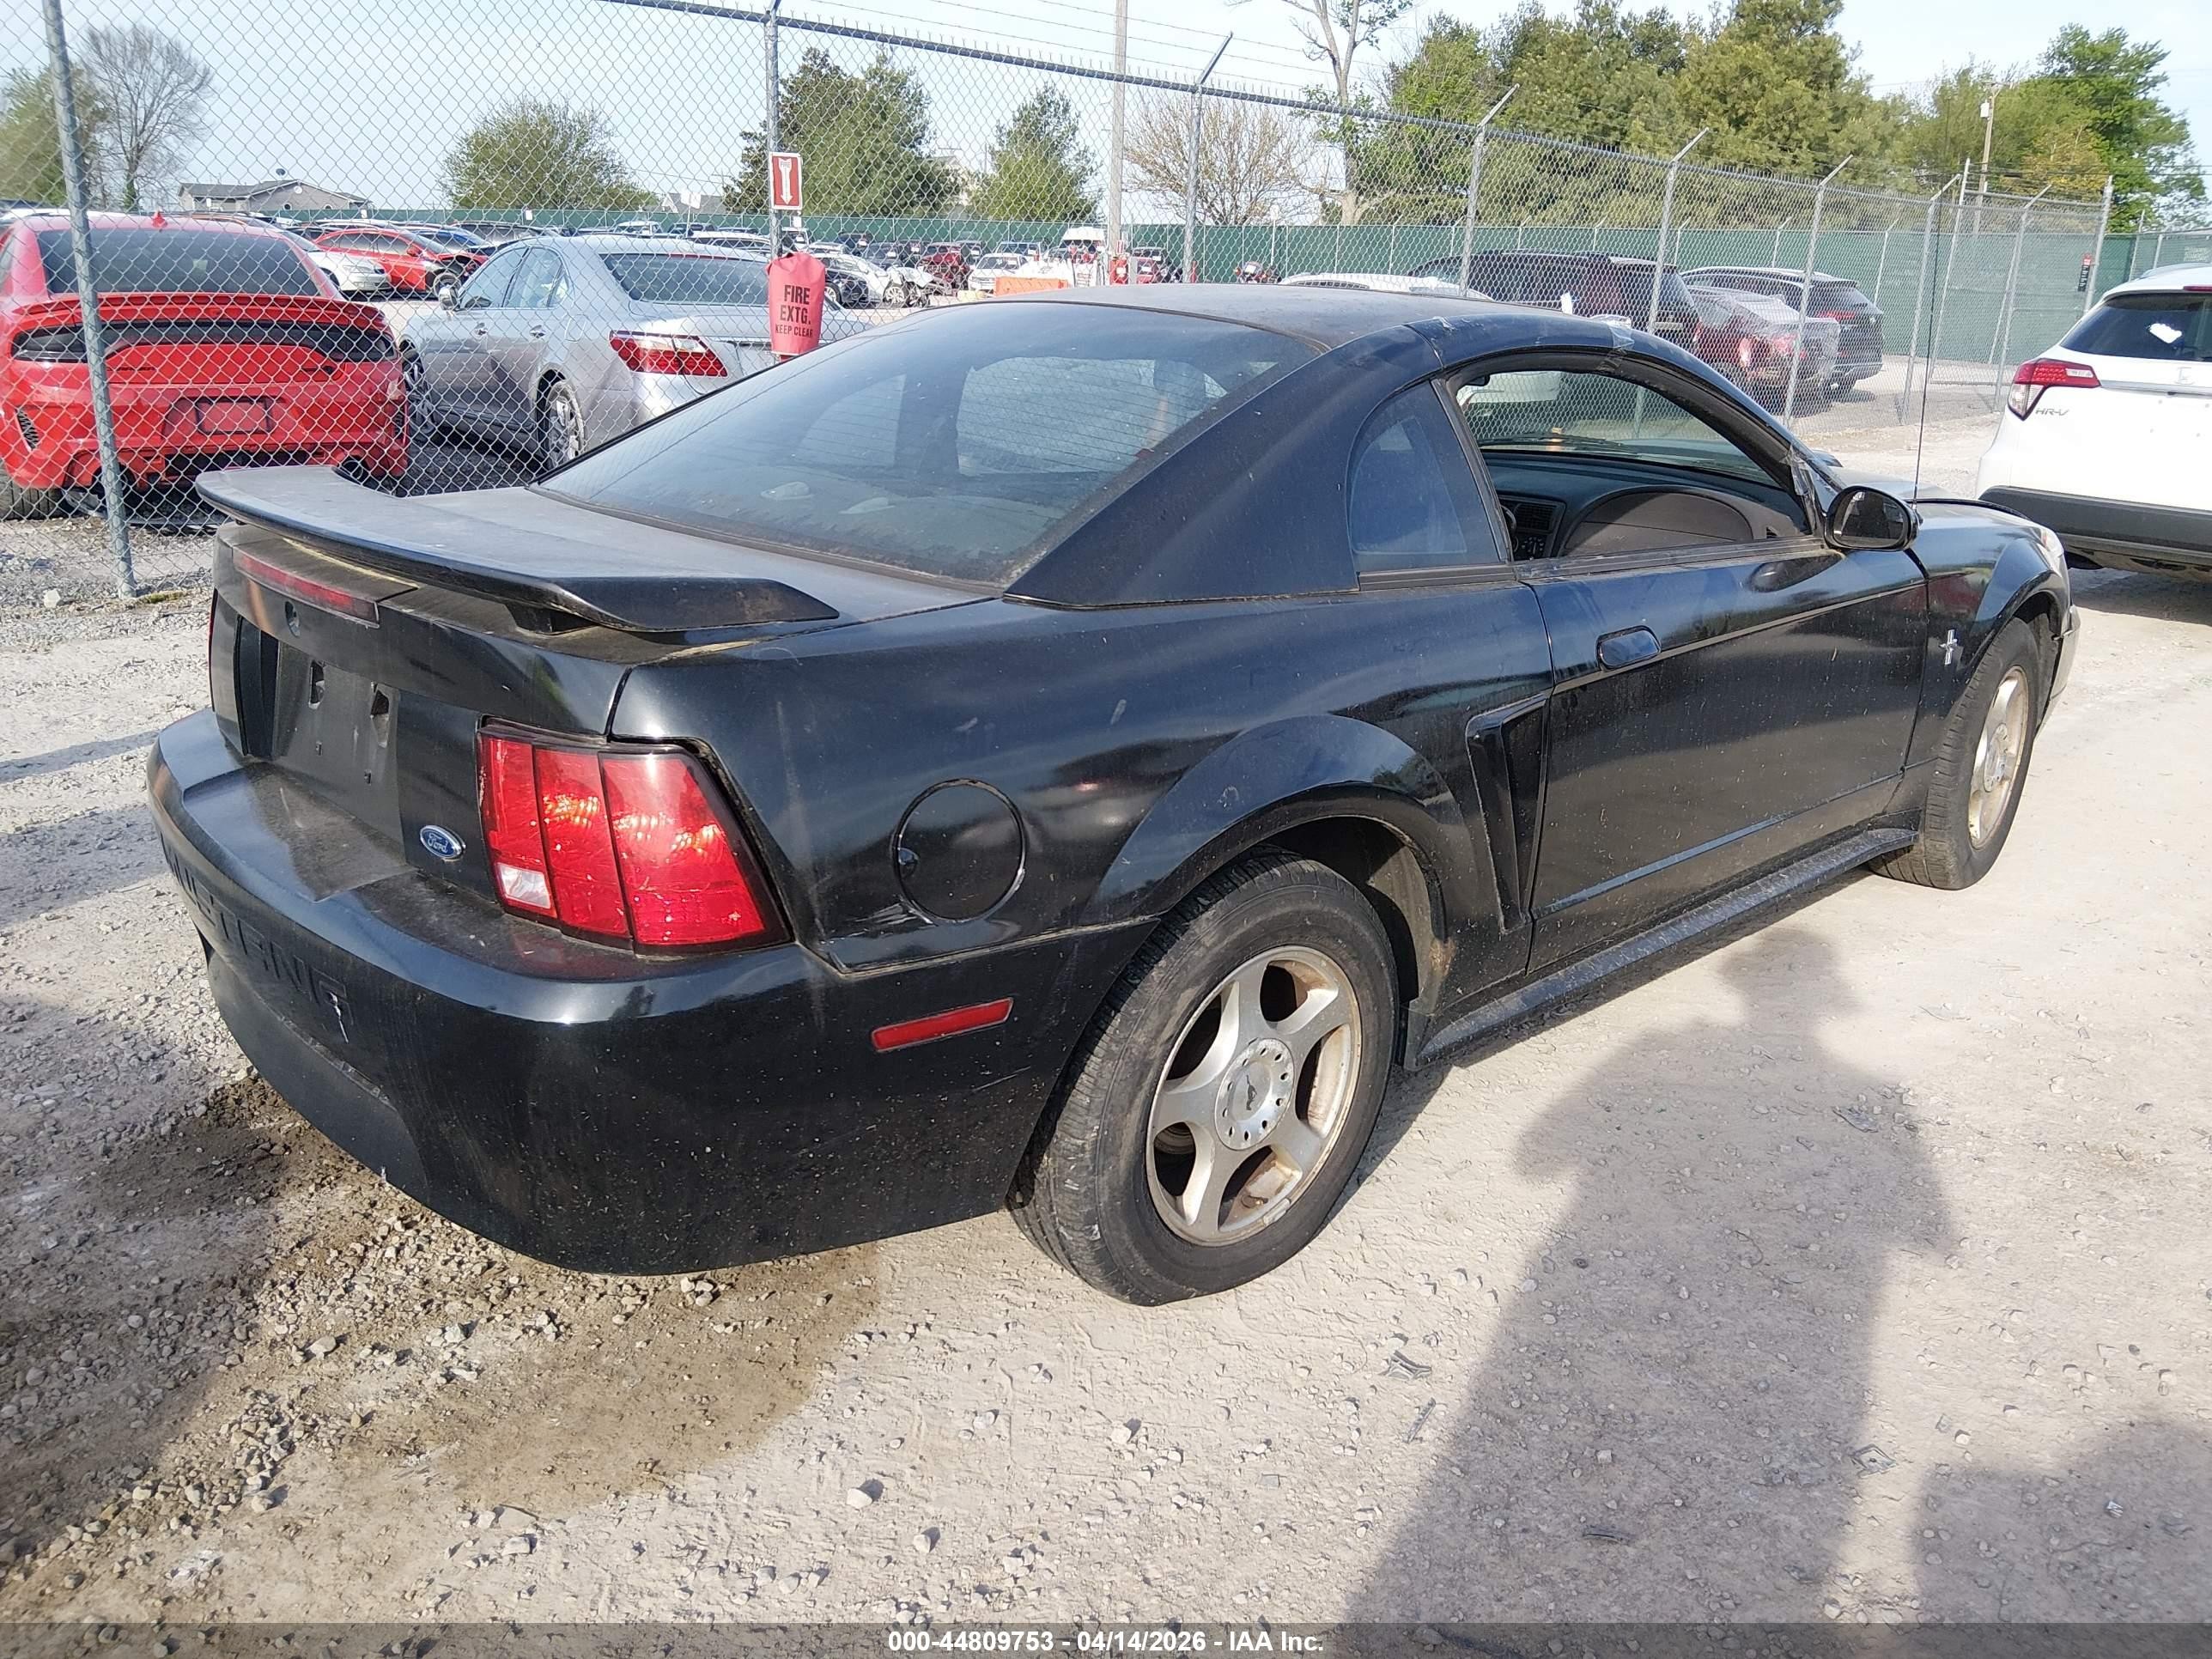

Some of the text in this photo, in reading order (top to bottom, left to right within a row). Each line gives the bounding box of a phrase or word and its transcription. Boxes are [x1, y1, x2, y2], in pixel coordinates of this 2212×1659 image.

[784, 284, 811, 305] FIRE
[780, 304, 811, 325] EXTG.
[775, 323, 793, 335] KEEP
[2035, 408, 2069, 416] HR-V
